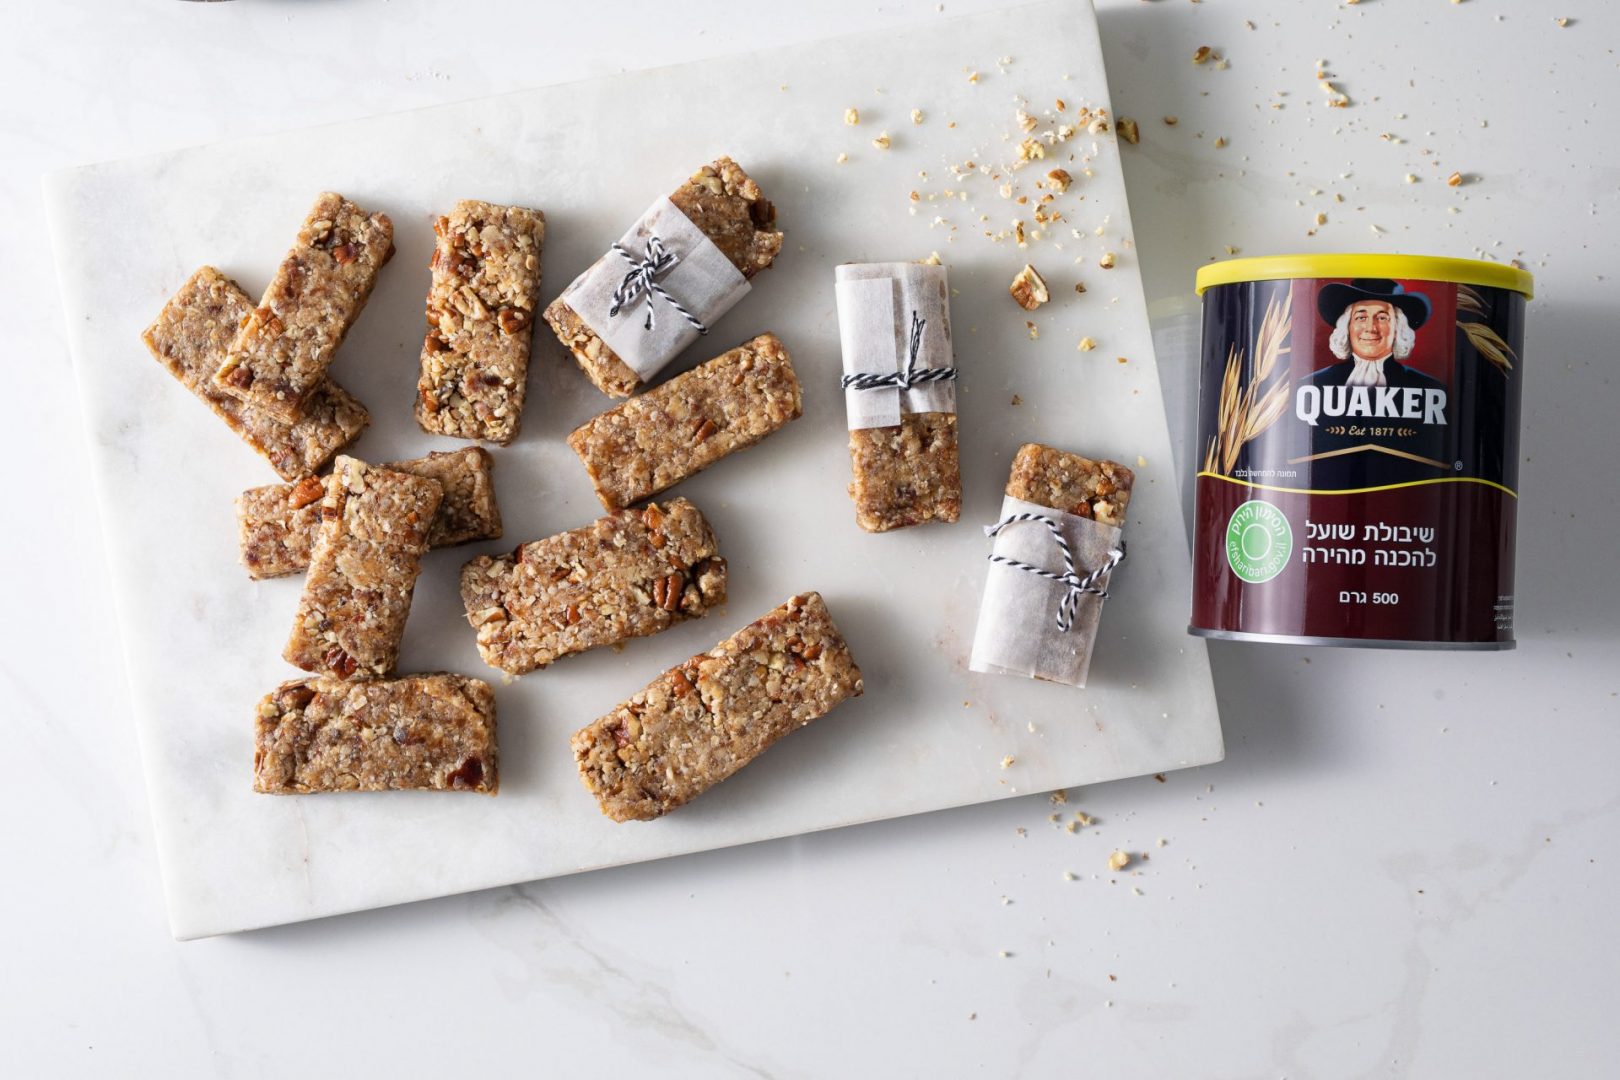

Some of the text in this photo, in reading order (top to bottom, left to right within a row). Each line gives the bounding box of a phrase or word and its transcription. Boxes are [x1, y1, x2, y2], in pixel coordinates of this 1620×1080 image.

[1296, 385, 1447, 426] QUAKER
[1348, 425, 1394, 437] Est 1877
[1231, 506, 1286, 537] הסימון הירוק
[1305, 520, 1435, 543] שיבולת שועל
[1302, 547, 1437, 567] להכנה מהירה
[1339, 591, 1399, 605] 500 גרם
